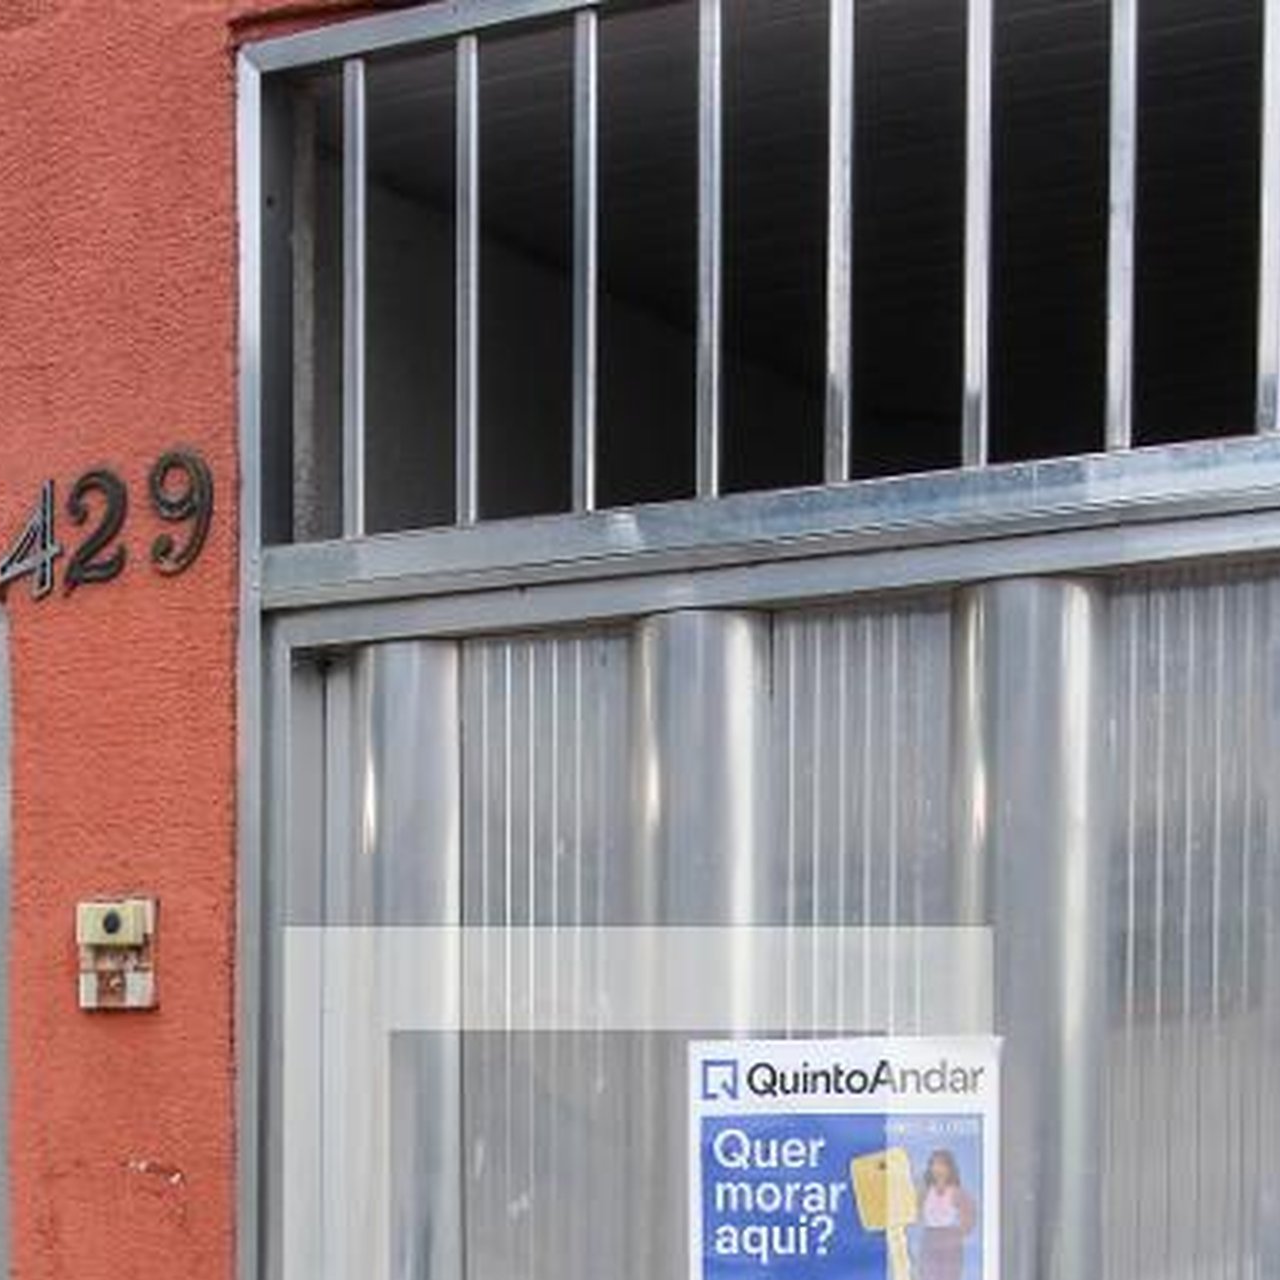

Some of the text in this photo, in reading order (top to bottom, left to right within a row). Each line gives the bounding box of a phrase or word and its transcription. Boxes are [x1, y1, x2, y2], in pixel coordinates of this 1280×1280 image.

[747, 1059, 984, 1096] QuintoAndar
[713, 1128, 825, 1170] Quer
[716, 1182, 846, 1212] morar
[716, 1214, 833, 1265] aqui?
